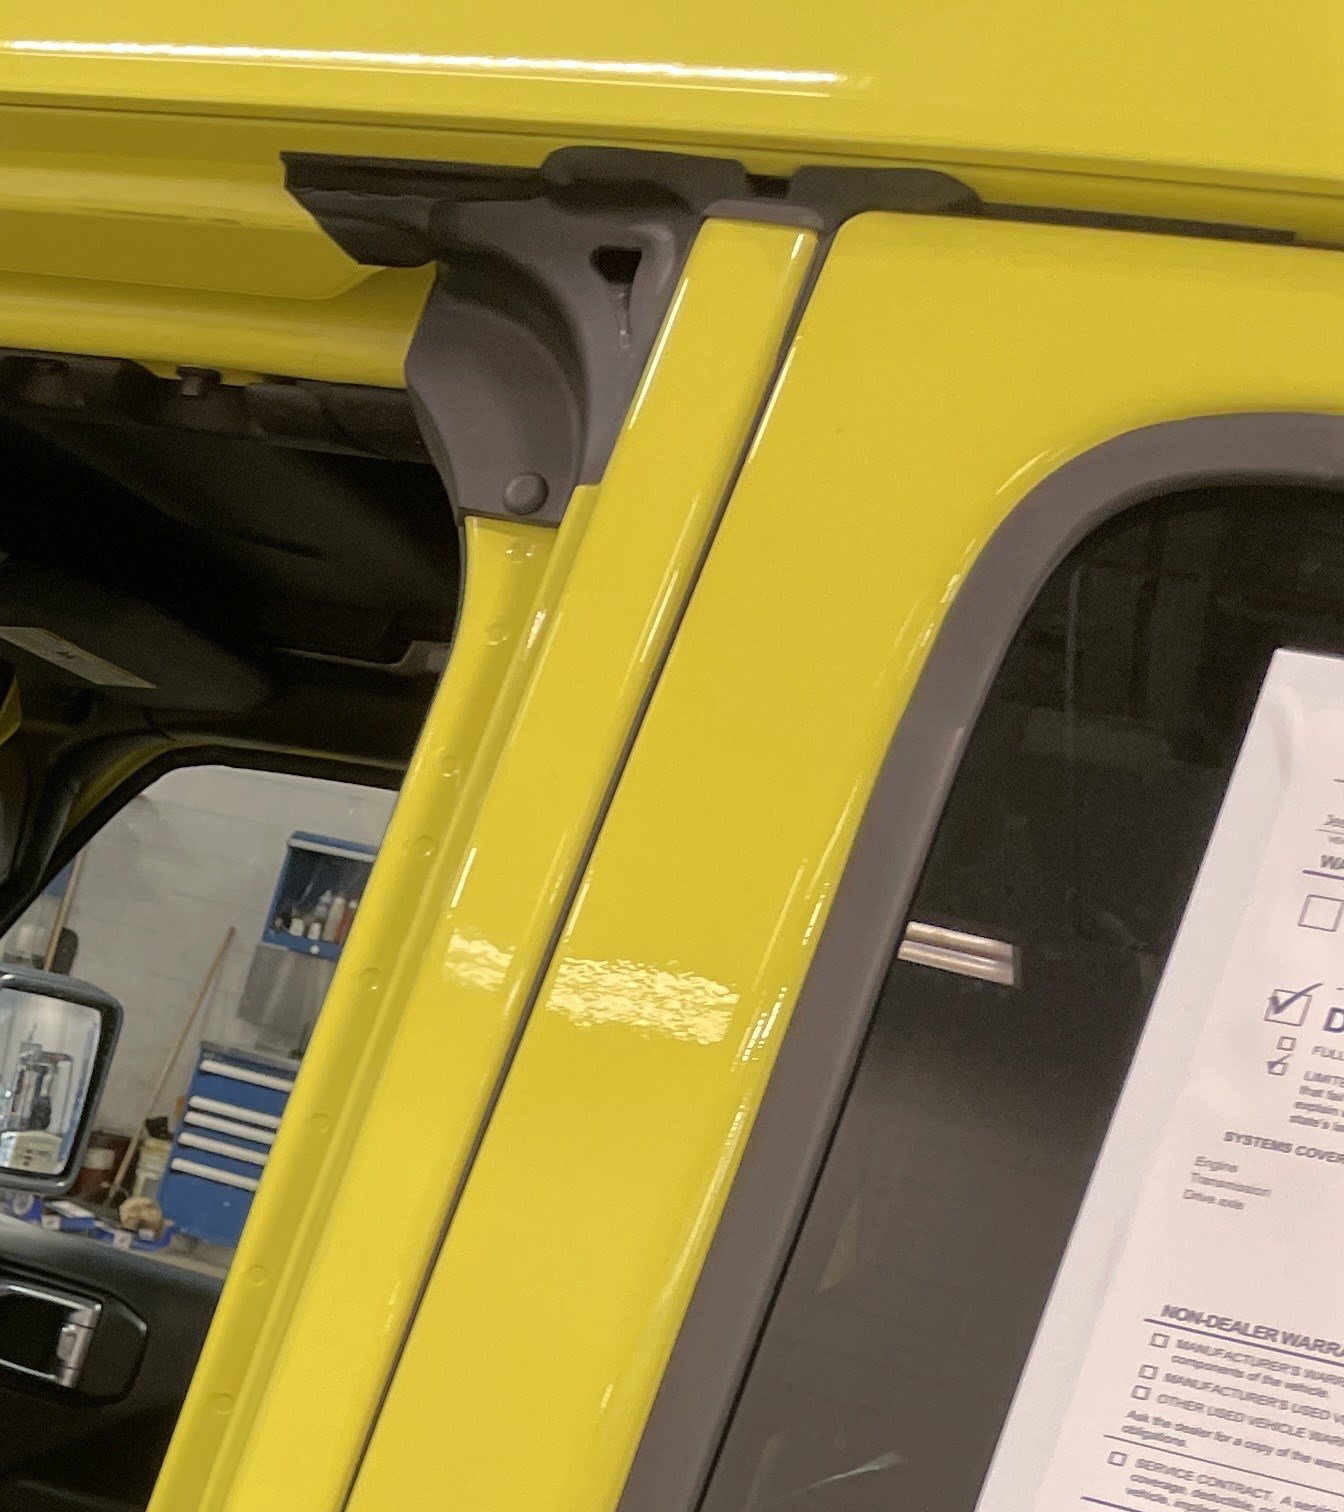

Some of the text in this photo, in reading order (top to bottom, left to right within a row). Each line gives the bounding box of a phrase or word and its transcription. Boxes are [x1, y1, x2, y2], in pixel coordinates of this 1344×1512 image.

[1224, 1132, 1293, 1153] SYSTEMS
[1194, 1156, 1238, 1173] Engine
[1183, 1189, 1216, 1204] Drive
[1161, 1305, 1280, 1342] NON-DEALER
[1171, 1356, 1245, 1378] components
[1245, 1373, 1262, 1381] of
[1261, 1375, 1282, 1387] the
[1176, 1339, 1302, 1376] MANUFACTURER'S
[1164, 1373, 1289, 1410] MANUFACTURER'S
[1291, 1403, 1331, 1420] USED
[1157, 1394, 1205, 1413] OTHER
[1207, 1406, 1246, 1422] USED
[1248, 1416, 1306, 1438] VEHICLE
[1126, 1411, 1149, 1422] Ask
[1152, 1417, 1172, 1428] the
[1174, 1423, 1213, 1438] dealer
[1214, 1431, 1232, 1442] for
[1244, 1441, 1274, 1455] copy
[1276, 1449, 1291, 1457] of
[1291, 1451, 1312, 1463] the
[1135, 1459, 1195, 1481] SERVICE
[1280, 1496, 1291, 1506] A
